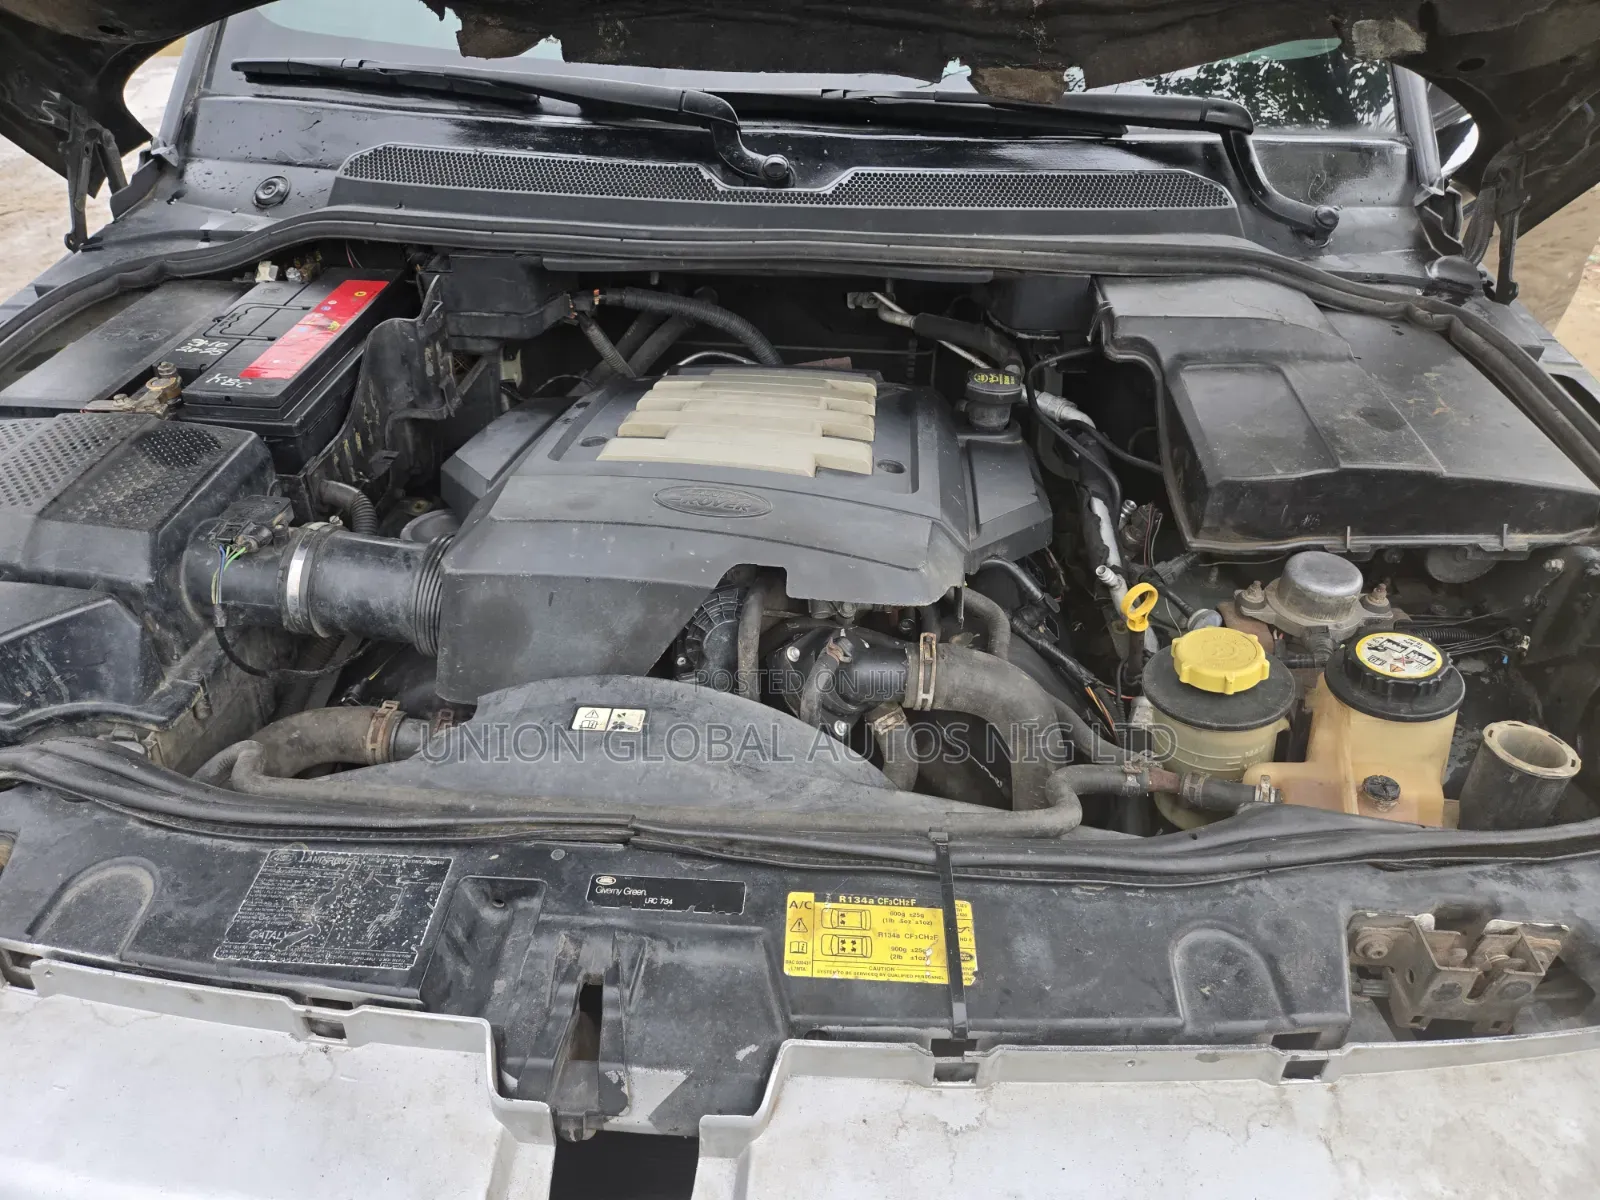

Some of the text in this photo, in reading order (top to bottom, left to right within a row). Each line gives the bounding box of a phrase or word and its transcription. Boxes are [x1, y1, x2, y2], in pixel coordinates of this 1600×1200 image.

[595, 885, 646, 896] Giverny Green
[788, 900, 812, 910] A/C
[839, 895, 917, 907] R134a CF3CH2F
[877, 931, 901, 939] R134a
